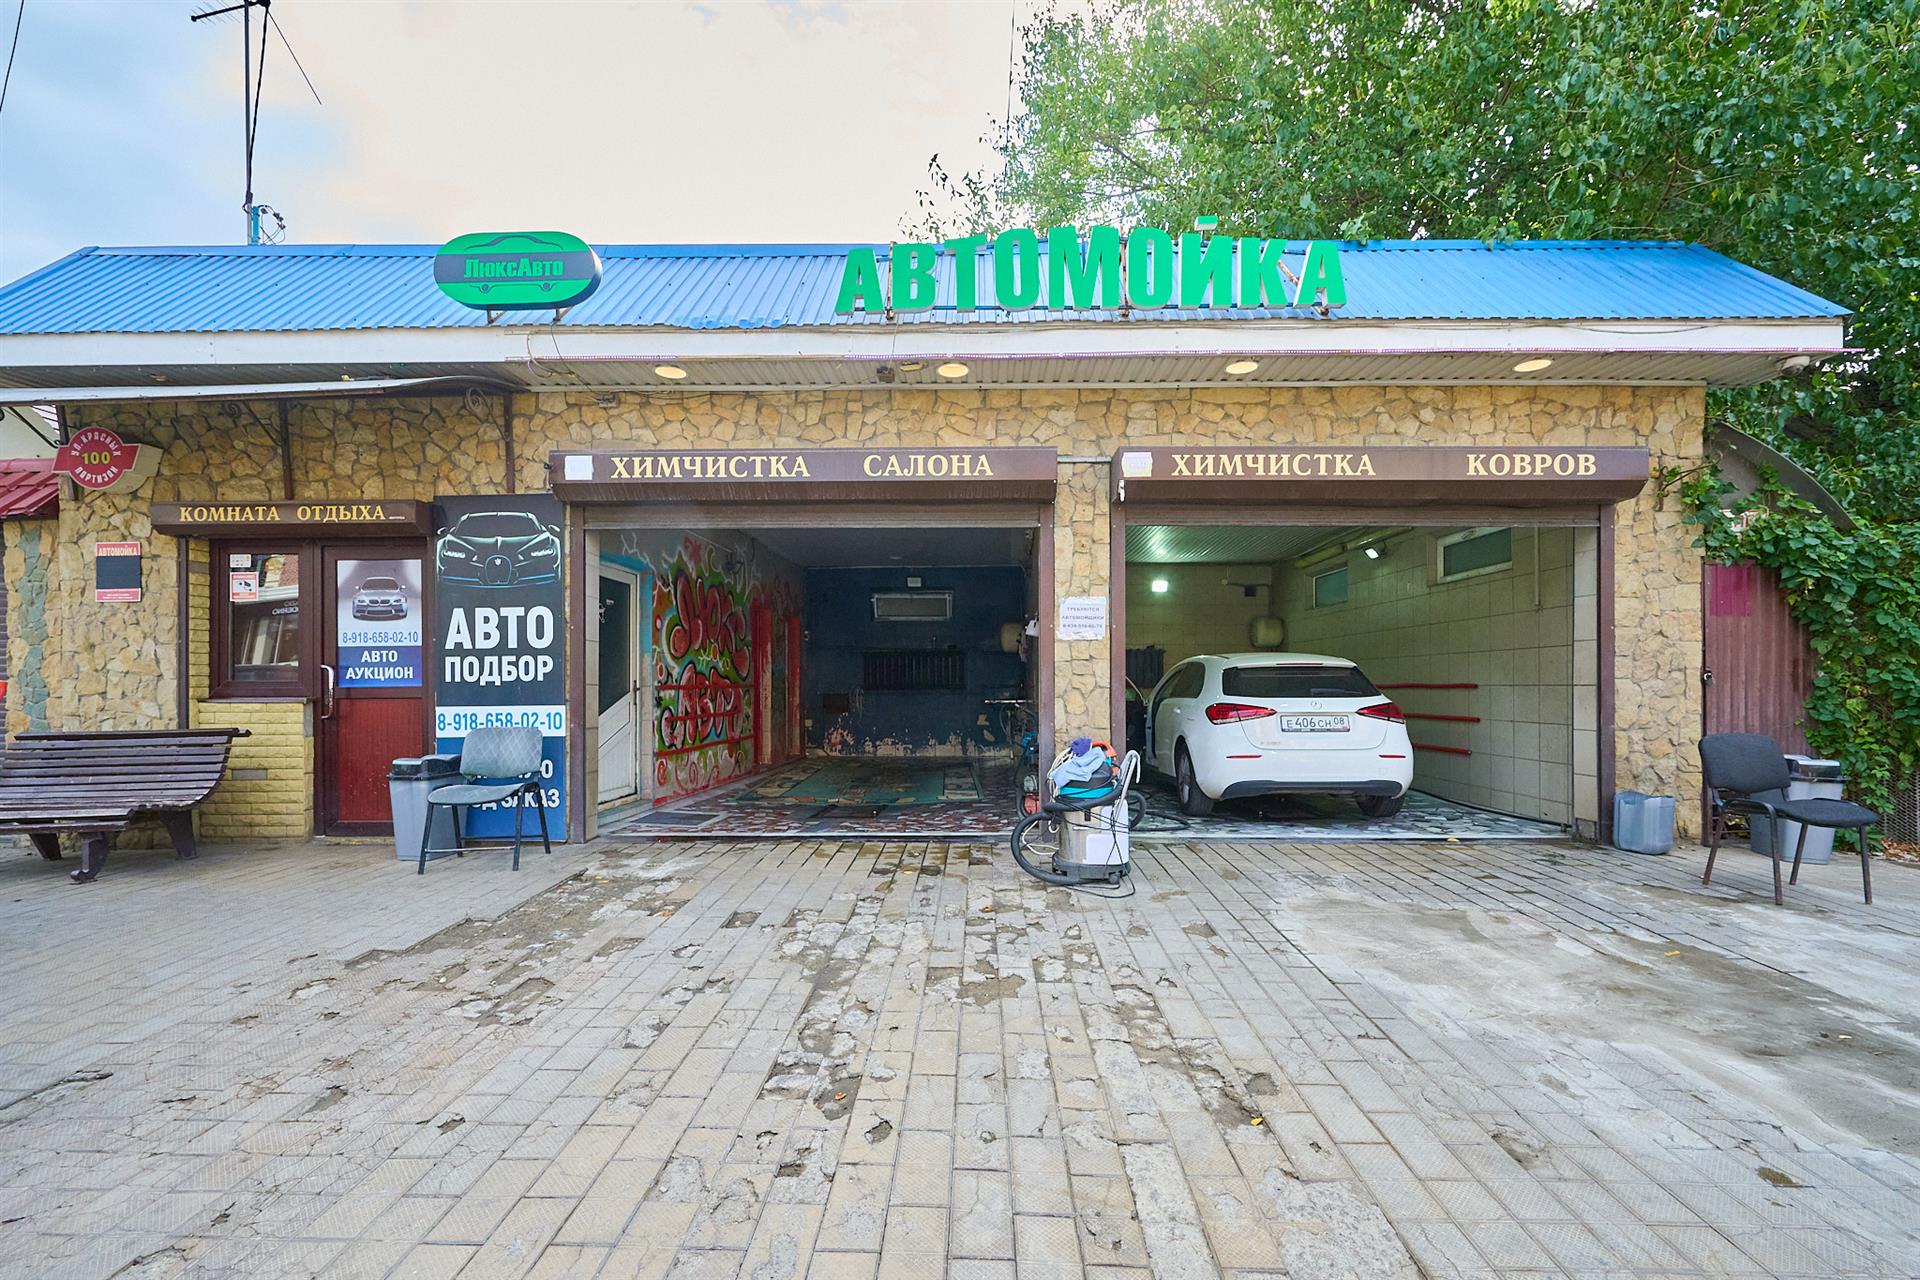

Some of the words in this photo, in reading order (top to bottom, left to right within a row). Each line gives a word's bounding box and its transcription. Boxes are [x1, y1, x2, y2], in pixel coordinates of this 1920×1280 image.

[835, 215, 1347, 315] АВТОМОЙКА
[81, 451, 111, 465] 100
[610, 455, 811, 480] ХИМЧИСТКА
[862, 453, 995, 479] САЛОНА
[1170, 453, 1377, 477] ХИМЧИСТКА
[1466, 452, 1598, 477] КОВРОВ
[74, 465, 119, 484] ПАРТИЗАН
[179, 505, 281, 523] КОМНАТА
[296, 504, 386, 523] ОТДЫХА
[98, 545, 138, 557] АВТОМОЙКА
[342, 631, 419, 643] 8-918-658-02-10
[444, 606, 554, 650] АВТО
[360, 650, 399, 663] АВТО
[345, 666, 414, 681] АУКЦИОН
[444, 655, 554, 686] ПОДБОР
[437, 711, 563, 732] 8-918-658-02-10
